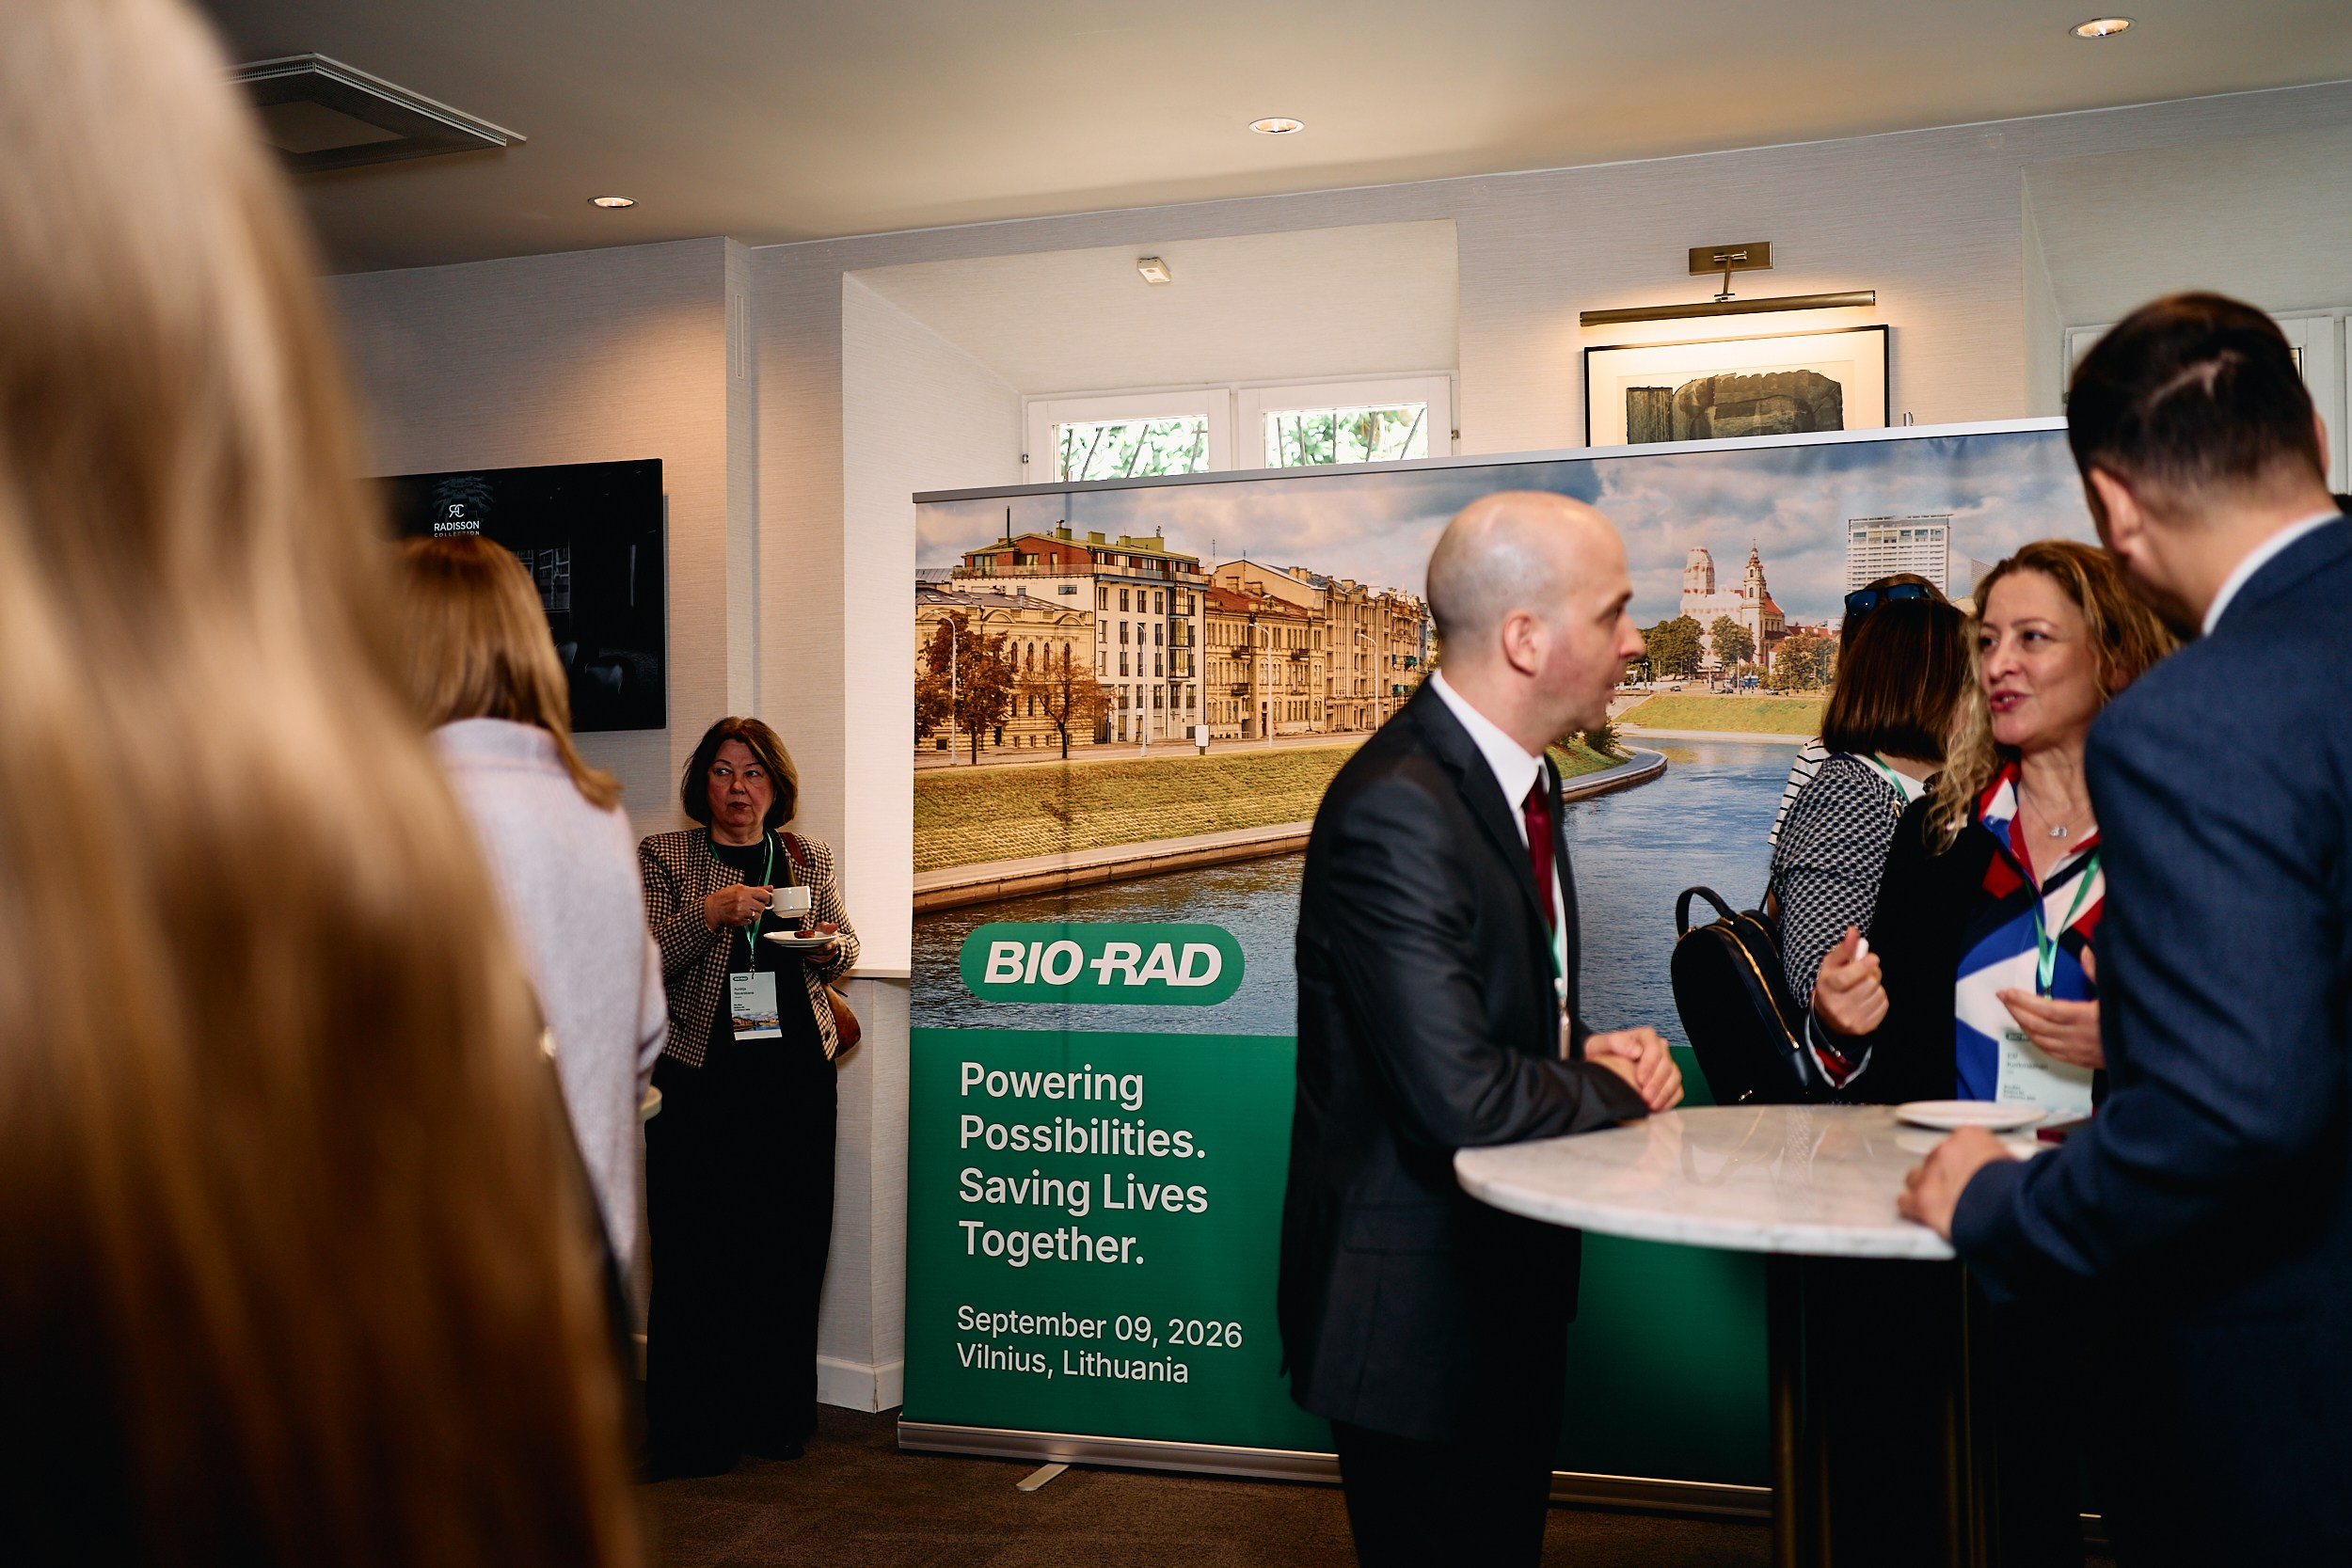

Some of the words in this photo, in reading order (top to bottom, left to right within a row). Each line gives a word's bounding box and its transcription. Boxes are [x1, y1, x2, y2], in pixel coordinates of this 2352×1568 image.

[434, 520, 480, 531] RADISSON
[983, 941, 1222, 987] BIO-RAD
[961, 1061, 1144, 1112] Powering
[961, 1114, 1207, 1159] Possibilities.
[959, 1166, 1090, 1217] Saving
[1104, 1172, 1209, 1213] Lives
[959, 1220, 1145, 1268] Together.
[957, 1305, 1107, 1339] September
[1115, 1315, 1159, 1349] 09,
[1168, 1318, 1243, 1348] 2026
[956, 1342, 1054, 1380] Vilnius,
[1063, 1349, 1189, 1384] Lithuania
